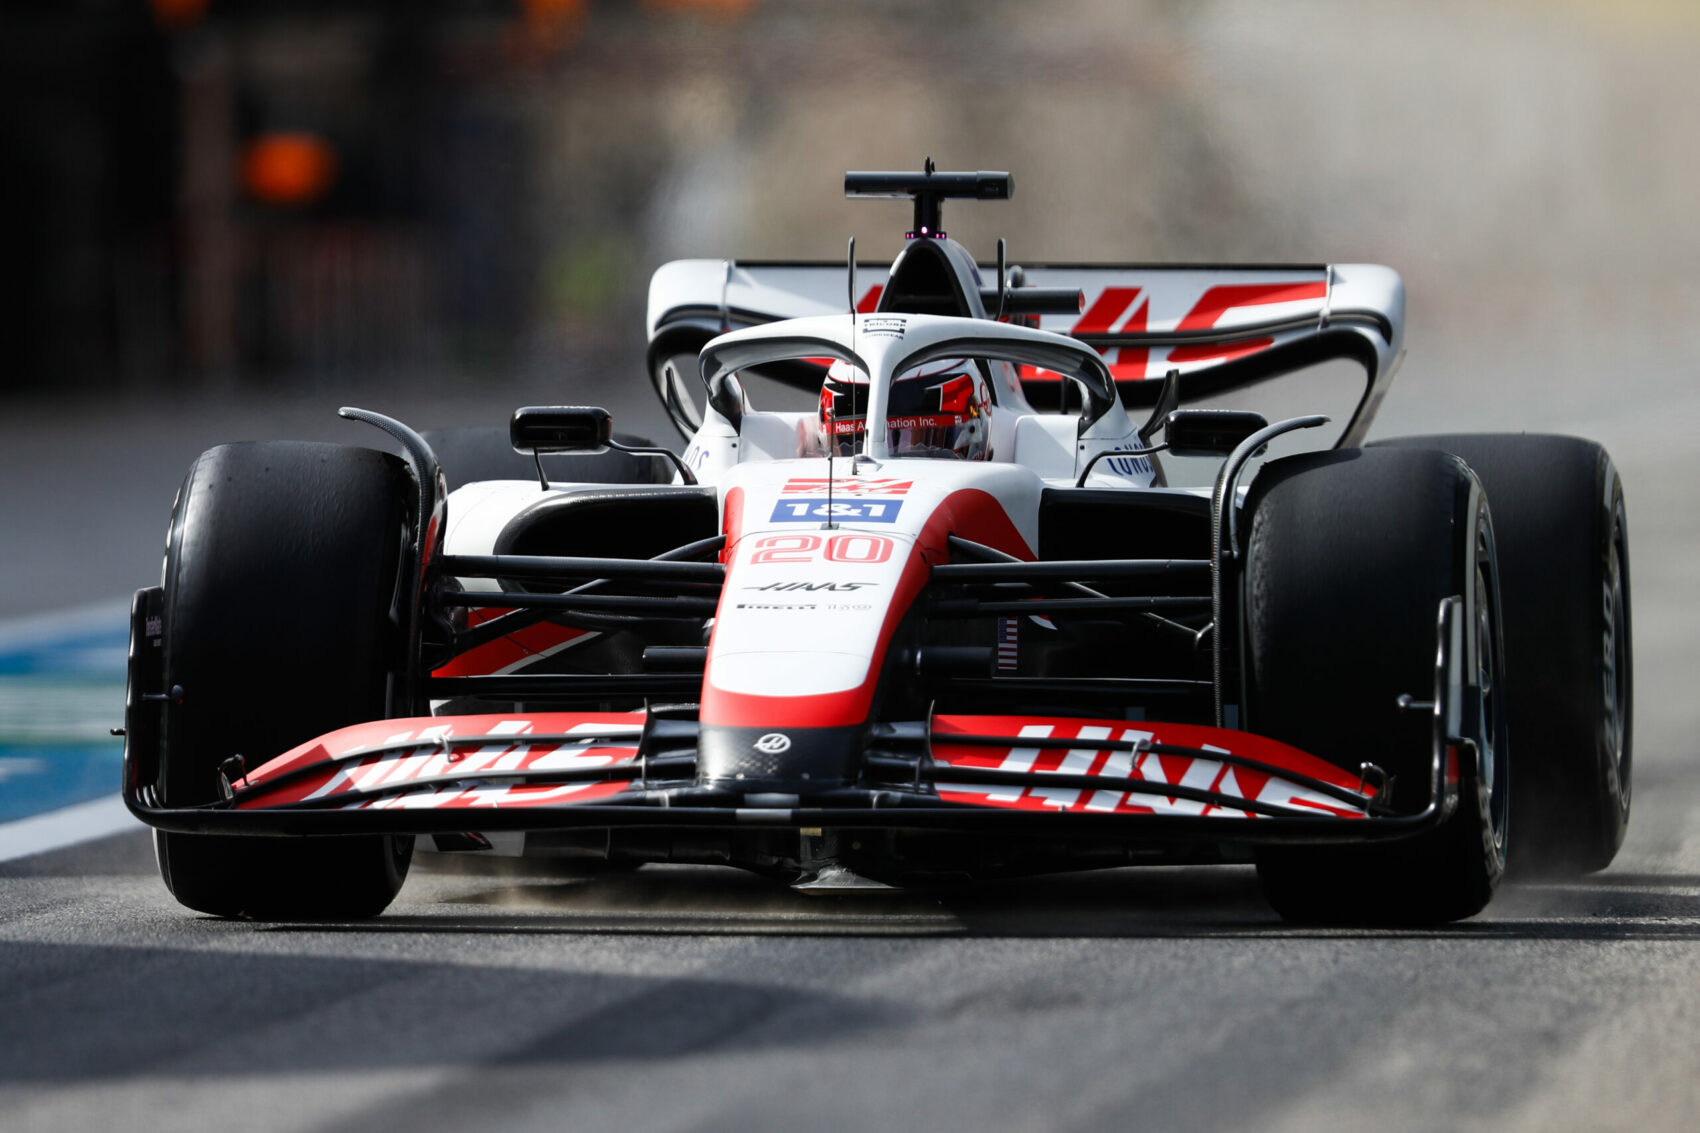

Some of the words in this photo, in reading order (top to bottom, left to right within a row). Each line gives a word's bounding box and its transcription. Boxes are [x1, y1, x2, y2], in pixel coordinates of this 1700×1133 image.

[835, 421, 855, 433] Haas
[857, 417, 916, 431] Aation
[919, 416, 937, 427] Inc.
[786, 503, 887, 517] 1&1
[750, 534, 895, 565] 20
[742, 582, 880, 592] HAAS
